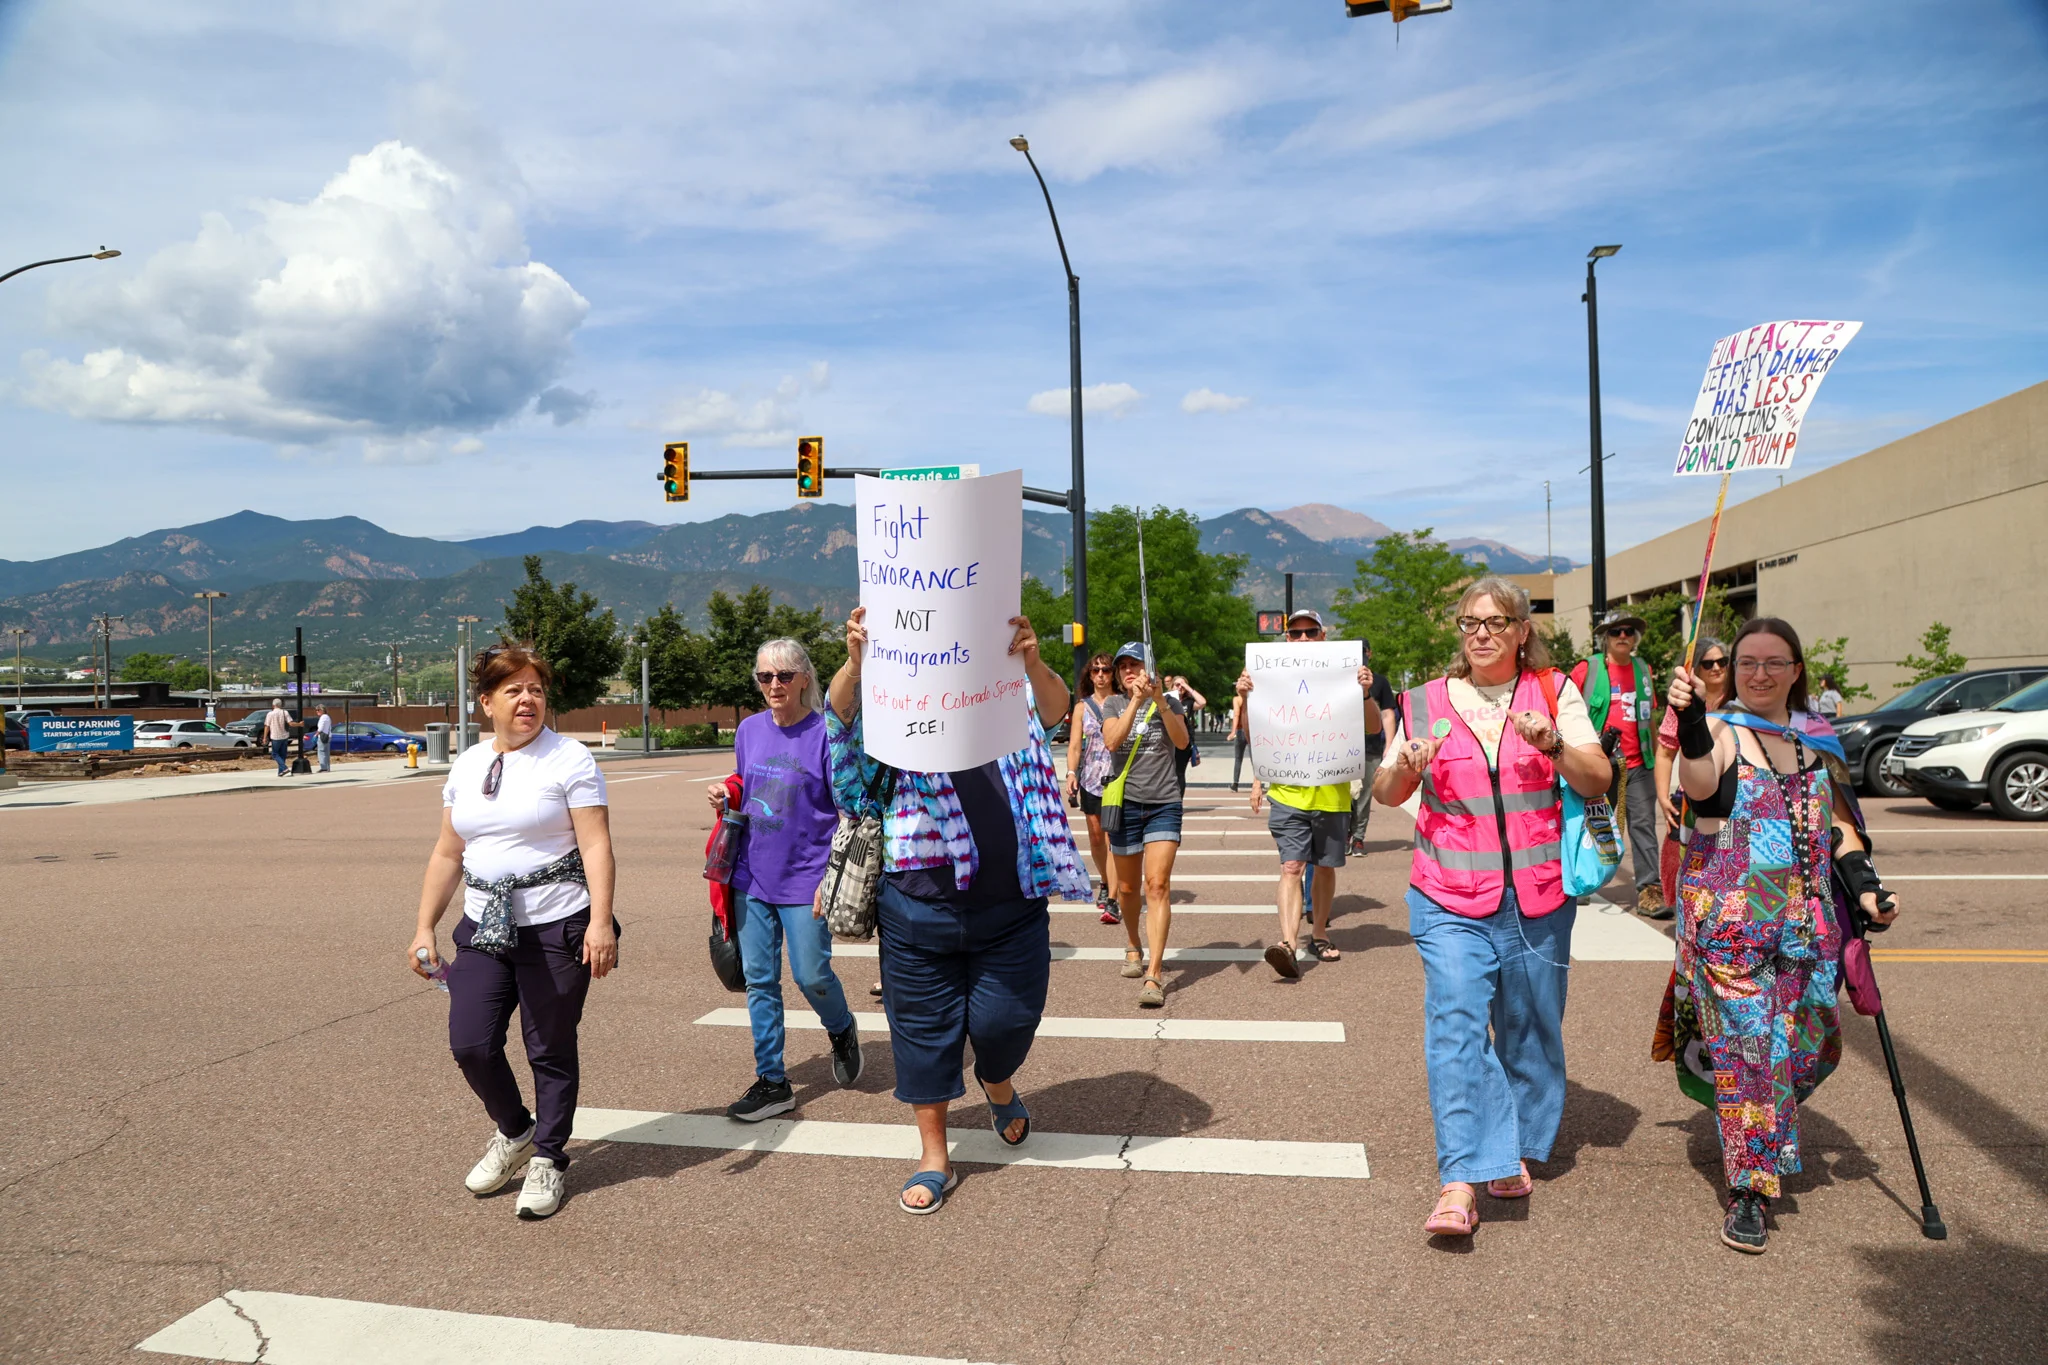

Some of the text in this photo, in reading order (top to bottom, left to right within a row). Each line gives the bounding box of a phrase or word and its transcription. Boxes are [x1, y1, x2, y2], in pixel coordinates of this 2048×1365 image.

[1709, 332, 1742, 367] FUN
[1703, 348, 1839, 393] JEFFREY DAHMER
[1712, 373, 1814, 416] HAS LESS
[1684, 404, 1800, 444] CONVICTIONS THAN
[1676, 431, 1797, 473] DONALD TRUMP
[883, 471, 943, 481] Cascade
[874, 504, 929, 559] Fight
[862, 560, 980, 592] IGNORANCE
[894, 608, 937, 632] NOT
[871, 639, 970, 678] Immigrants
[1254, 655, 1359, 671] DETENTION IS
[872, 677, 1025, 712] Get out of Colorado Springs
[1298, 679, 1309, 695] A
[42, 720, 120, 729] PUBLIC PARKING
[1268, 703, 1332, 725] MAGA
[1461, 707, 1506, 723] pea
[905, 719, 945, 738] ICE!
[1273, 747, 1360, 765] SAY HELL NO
[1259, 765, 1311, 779] COLORADO
